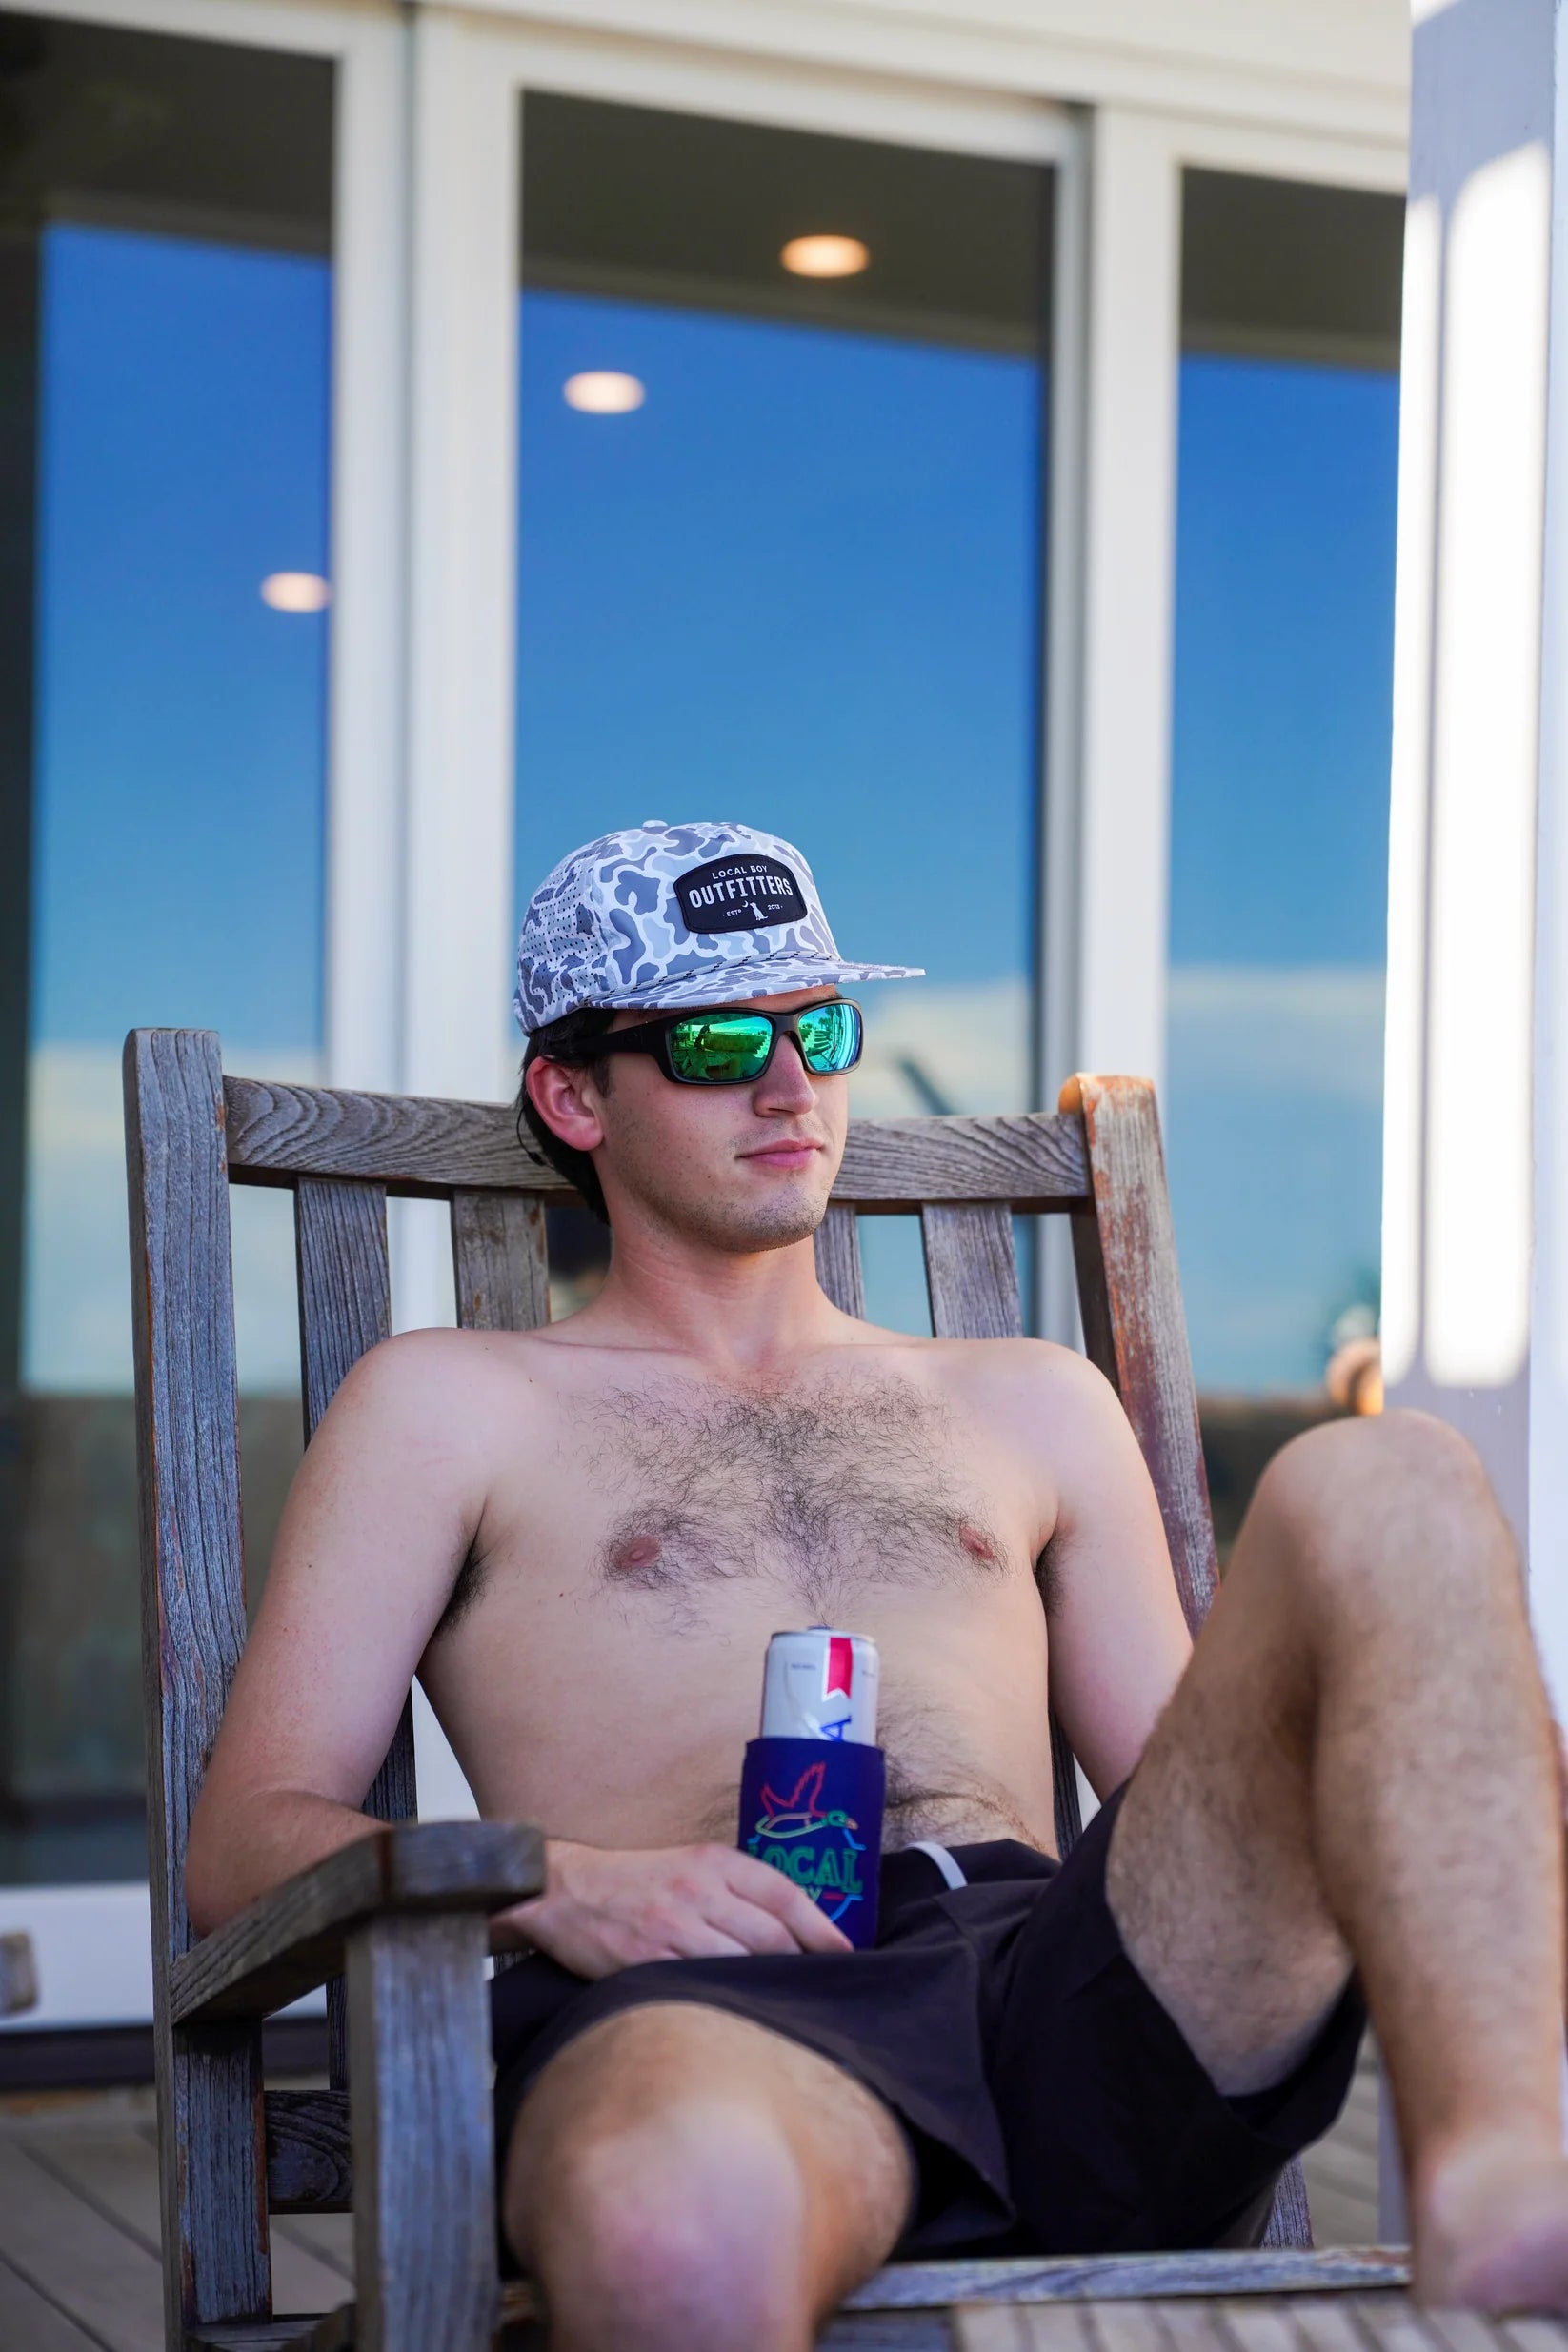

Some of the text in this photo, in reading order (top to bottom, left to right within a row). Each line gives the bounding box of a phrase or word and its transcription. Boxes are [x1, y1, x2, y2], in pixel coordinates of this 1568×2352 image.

[712, 865, 768, 879] LOCAL BOY
[688, 875, 794, 908] OUTFITTERS
